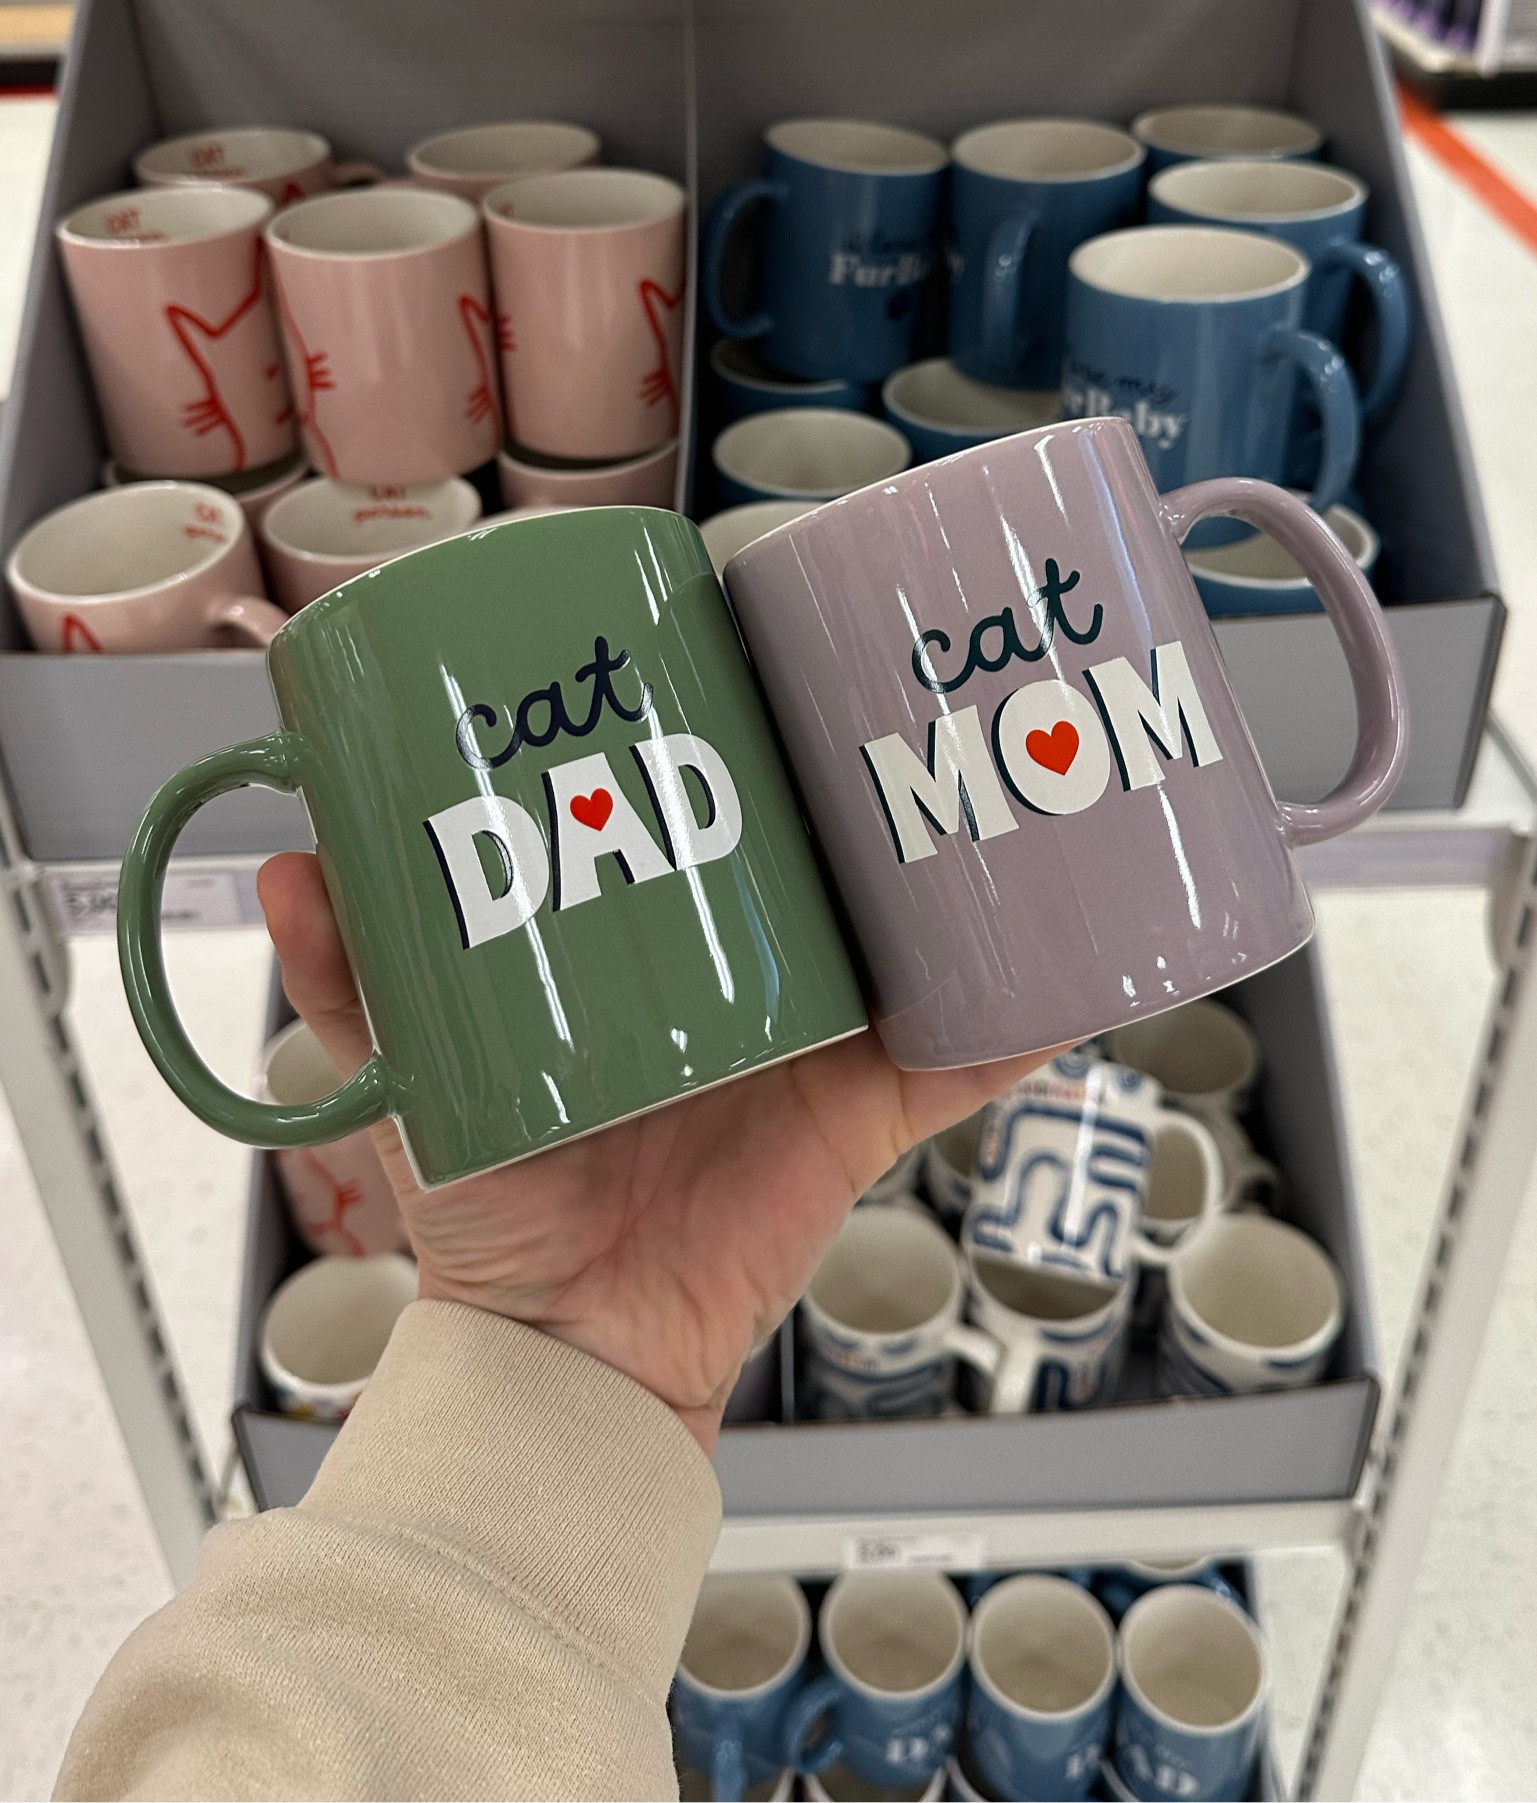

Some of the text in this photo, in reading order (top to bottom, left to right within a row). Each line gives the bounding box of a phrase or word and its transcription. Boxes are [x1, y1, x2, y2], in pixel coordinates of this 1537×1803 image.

[456, 636, 654, 771] cat
[911, 558, 1103, 694] cat
[859, 640, 1224, 865] MOM
[422, 733, 744, 951] DAD
